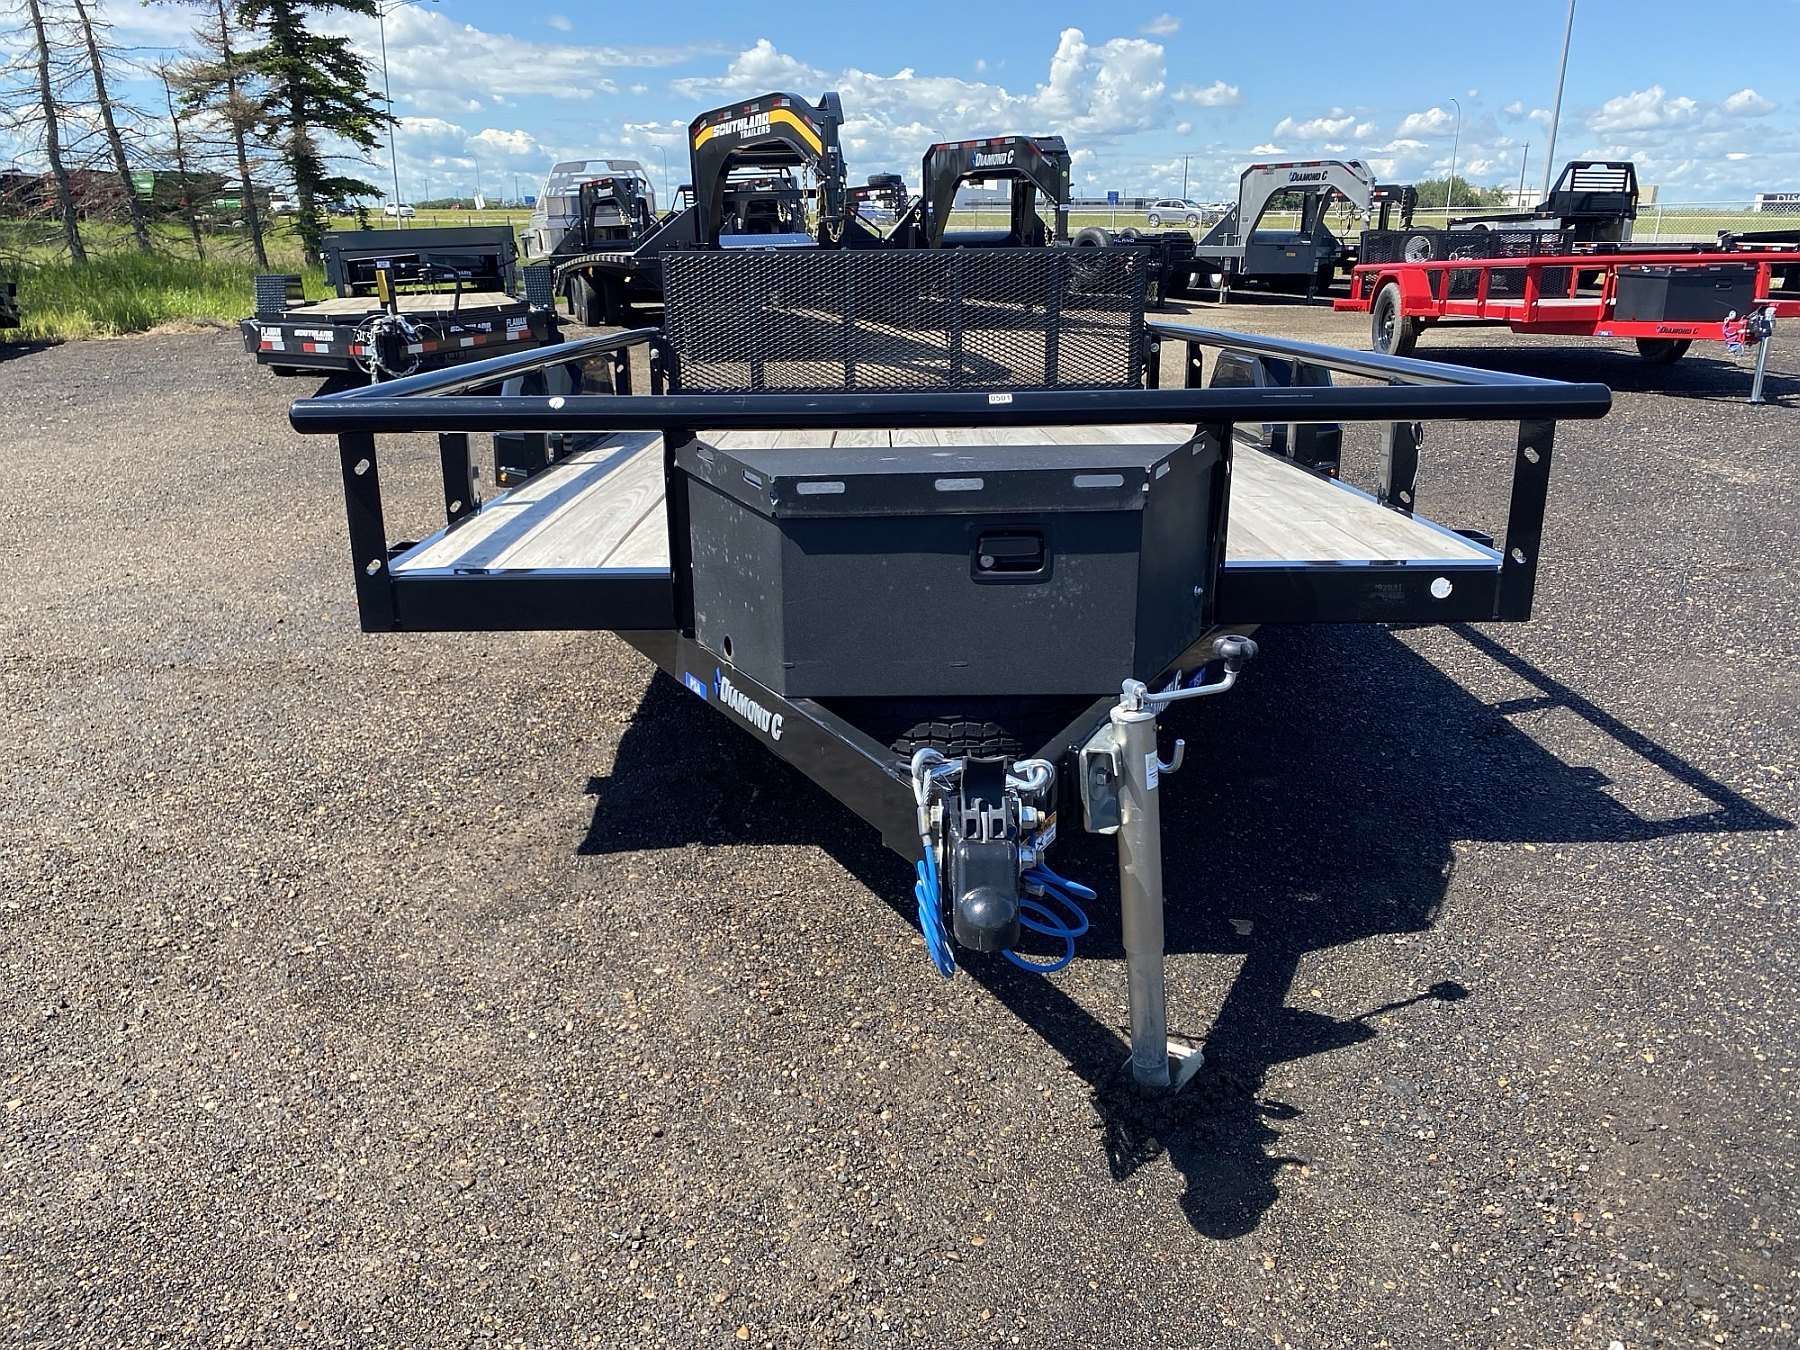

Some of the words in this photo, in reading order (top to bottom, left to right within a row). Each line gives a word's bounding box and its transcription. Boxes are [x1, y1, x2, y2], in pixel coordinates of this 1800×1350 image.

[713, 112, 769, 138] SOUTHLAND
[740, 124, 771, 139] TRAILERS
[975, 152, 1007, 167] DIAMOND
[1007, 149, 1015, 165] C
[1290, 171, 1321, 182] DIAMOND
[1321, 170, 1329, 181] C
[720, 676, 772, 733] DIAMOND
[770, 713, 784, 741] C
